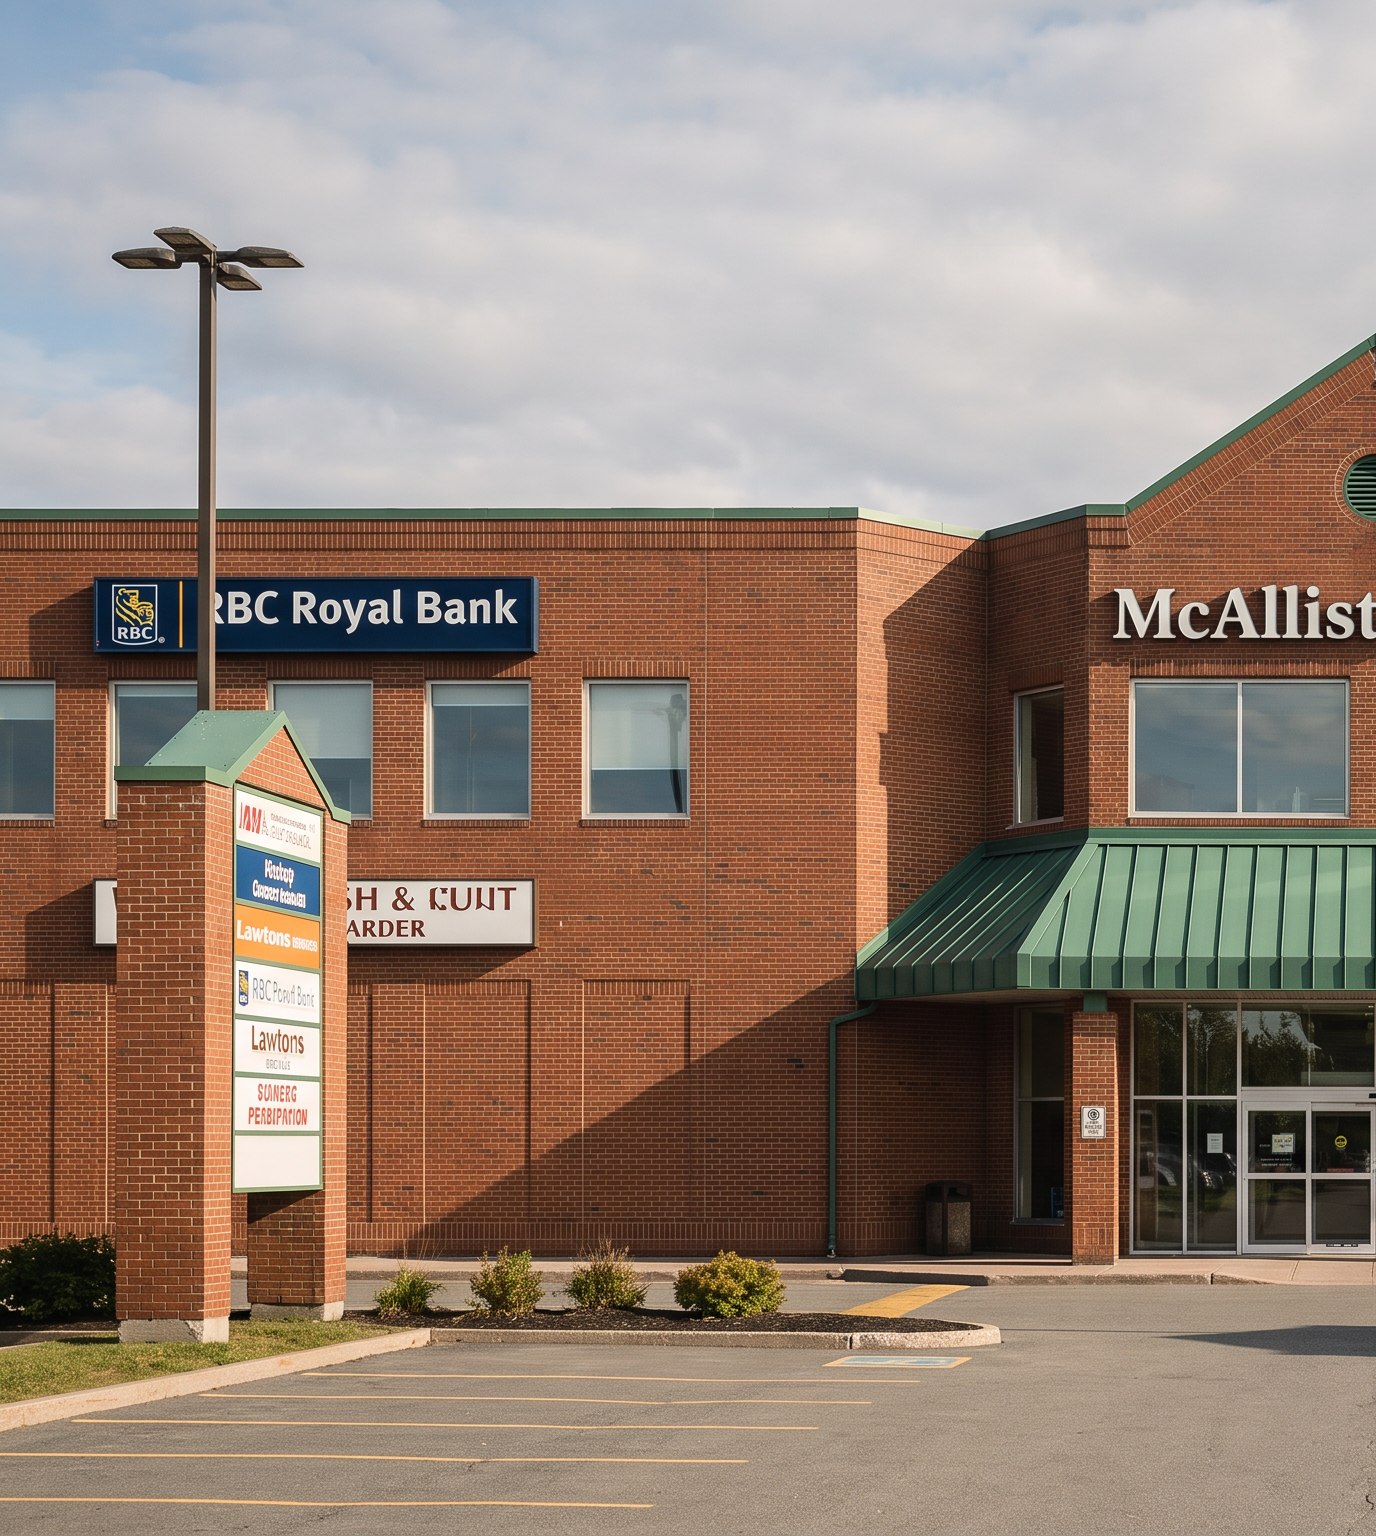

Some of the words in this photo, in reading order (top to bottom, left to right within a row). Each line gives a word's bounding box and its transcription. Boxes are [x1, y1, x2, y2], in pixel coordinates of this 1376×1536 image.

[292, 588, 404, 635] Royal
[417, 588, 518, 625] Bank
[117, 626, 153, 640] RBC
[391, 886, 415, 911] &
[236, 919, 291, 948] Lawtons
[251, 1025, 305, 1055] Lawtons
